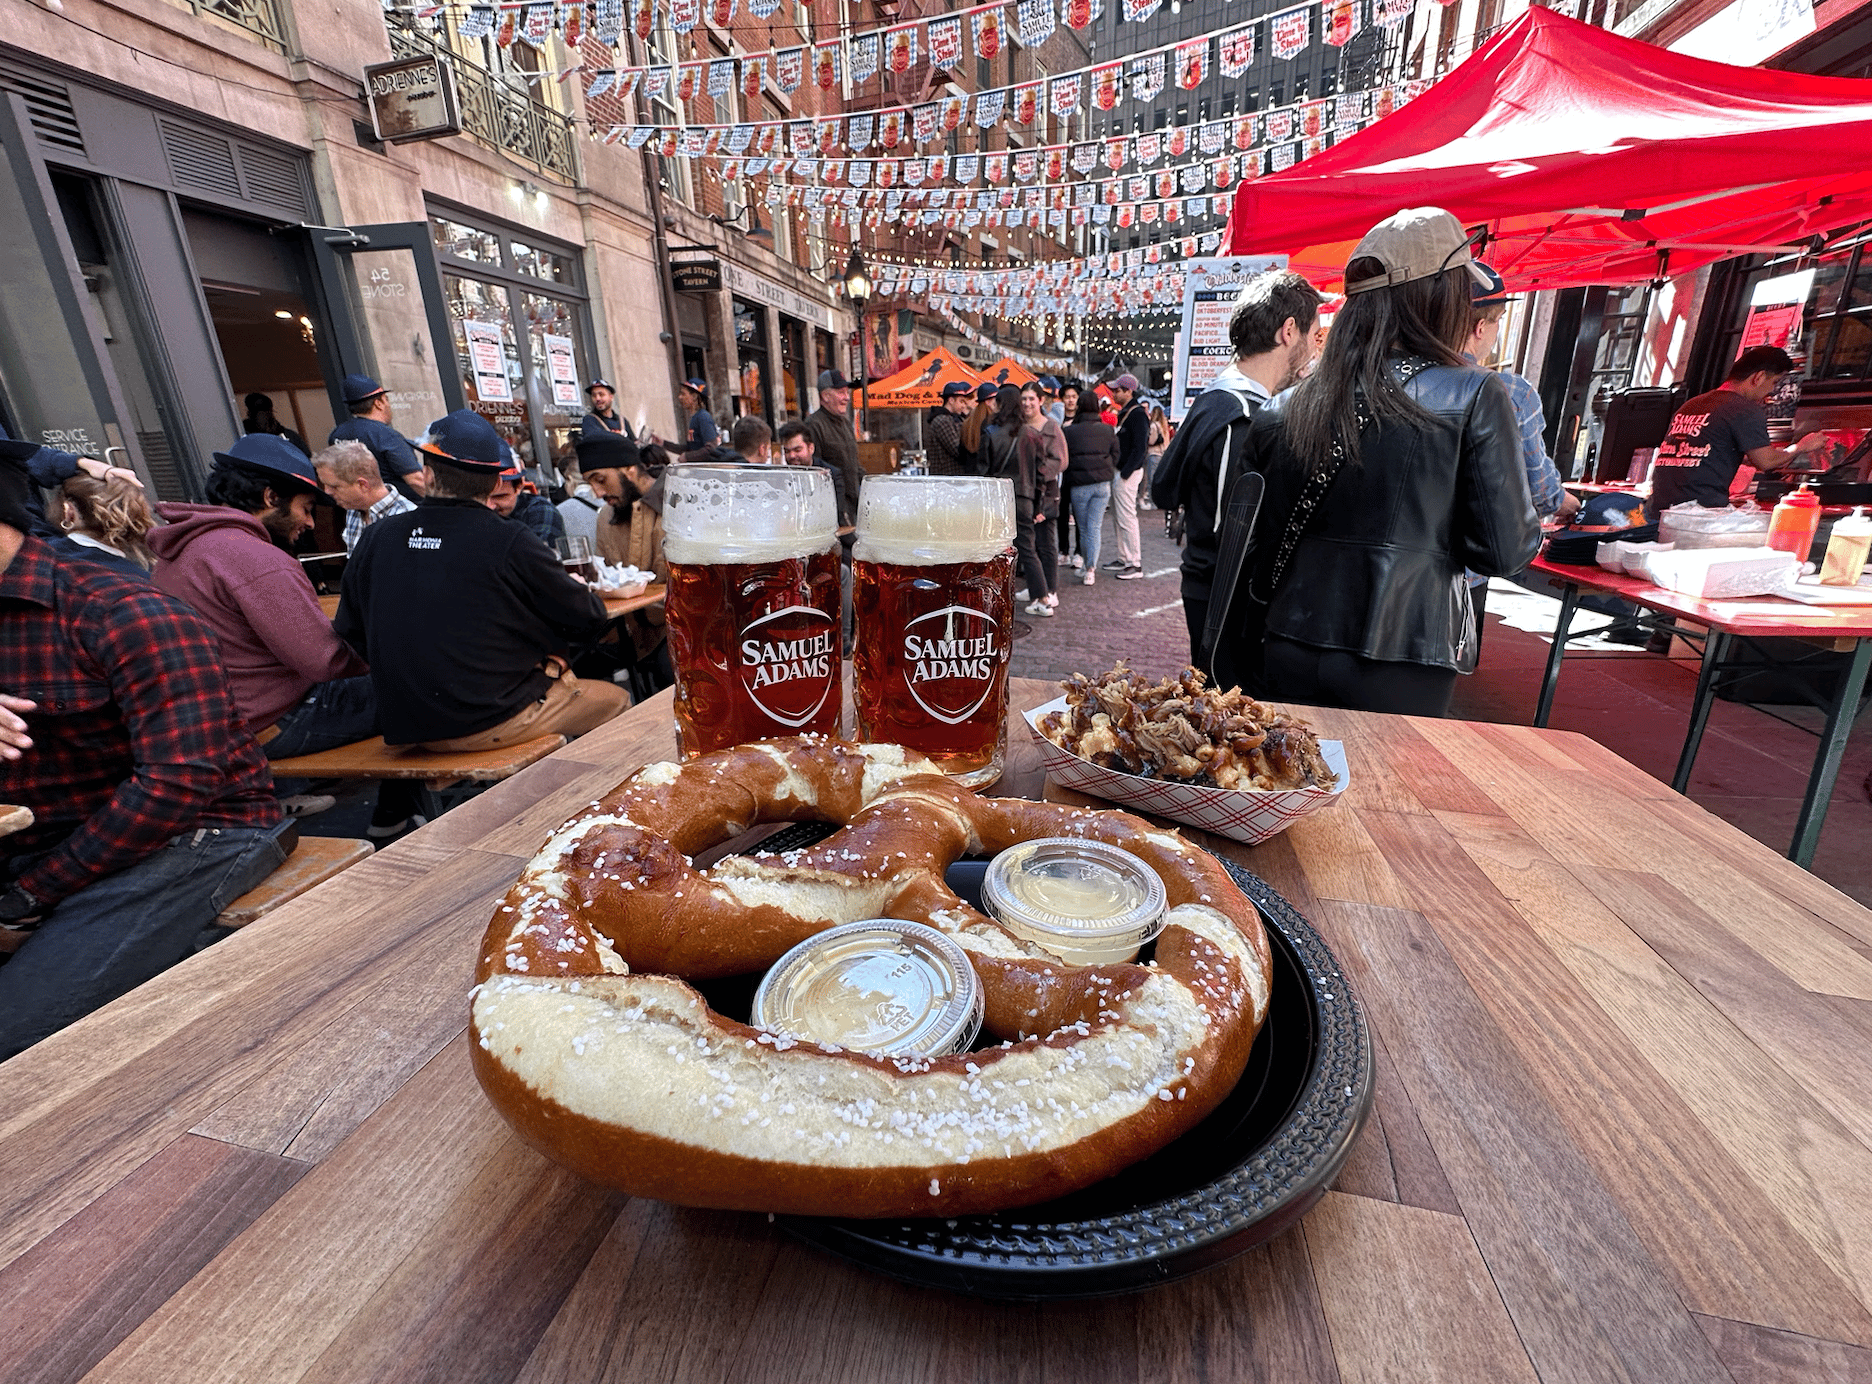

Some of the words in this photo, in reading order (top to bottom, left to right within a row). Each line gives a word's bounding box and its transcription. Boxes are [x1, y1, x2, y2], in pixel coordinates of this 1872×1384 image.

[1022, 14, 1051, 31] SAMUEL
[1025, 24, 1050, 37] ADAMS
[1275, 29, 1295, 41] Time
[1297, 24, 1305, 32] to
[931, 38, 949, 50] Time
[951, 33, 958, 43] to
[1055, 91, 1070, 101] Time
[672, 266, 692, 279] STONE
[693, 266, 719, 278] STREET
[683, 278, 709, 286] TAVERN
[756, 280, 785, 305] STREET
[1216, 291, 1239, 301] BEE
[895, 392, 920, 400] Dog
[923, 390, 934, 398] &
[1671, 412, 1711, 427] SAMUEL
[42, 428, 88, 443] SERVICE
[1668, 424, 1702, 437] ADAMS
[1676, 442, 1711, 457] Street
[741, 629, 835, 666] SAMUEL
[903, 632, 998, 662] SAMUEL
[751, 654, 830, 691] ADAMS
[911, 657, 992, 684] ADAMS
[892, 963, 912, 978] 115
[891, 1012, 915, 1031] PET
